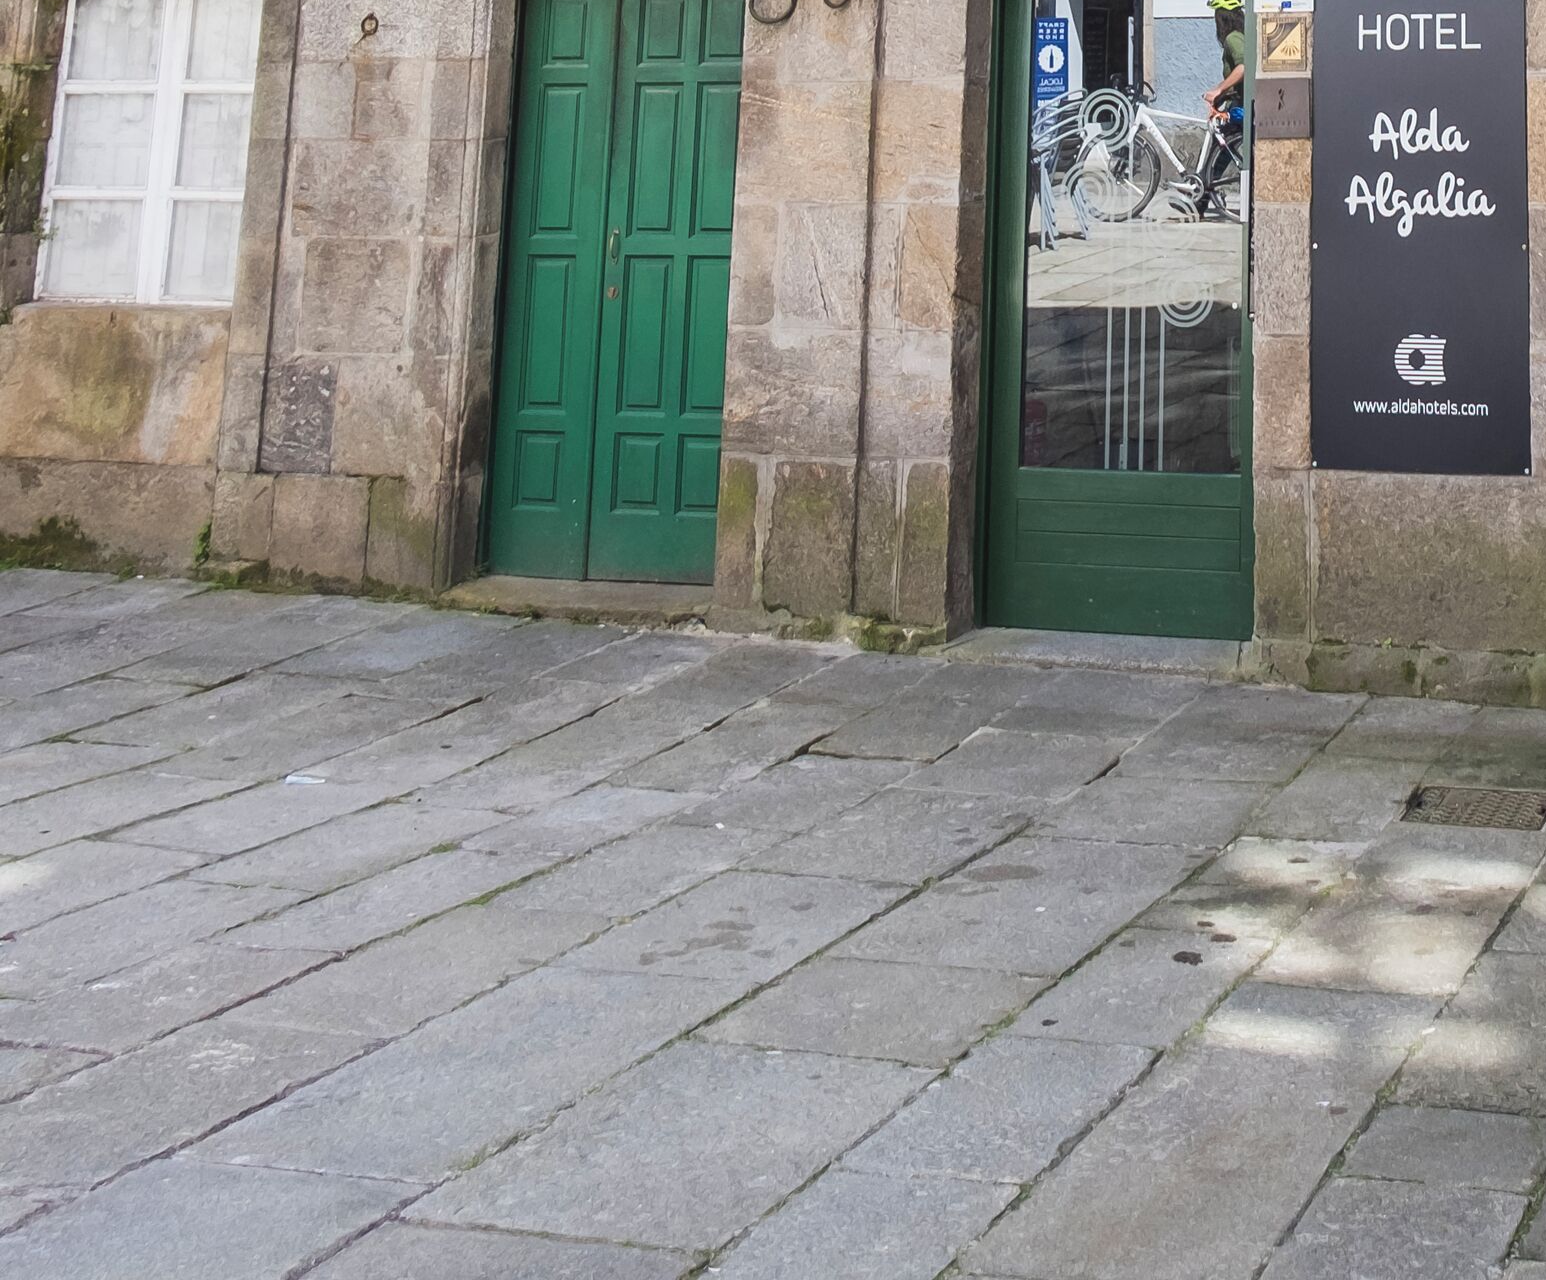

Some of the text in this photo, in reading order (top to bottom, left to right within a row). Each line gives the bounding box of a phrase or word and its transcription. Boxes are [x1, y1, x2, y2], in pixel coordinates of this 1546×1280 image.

[1357, 11, 1482, 51] HOTEL
[1367, 106, 1470, 160] Alda
[1343, 170, 1497, 238] Algalia
[1352, 396, 1490, 418] www.aldahotels.com
